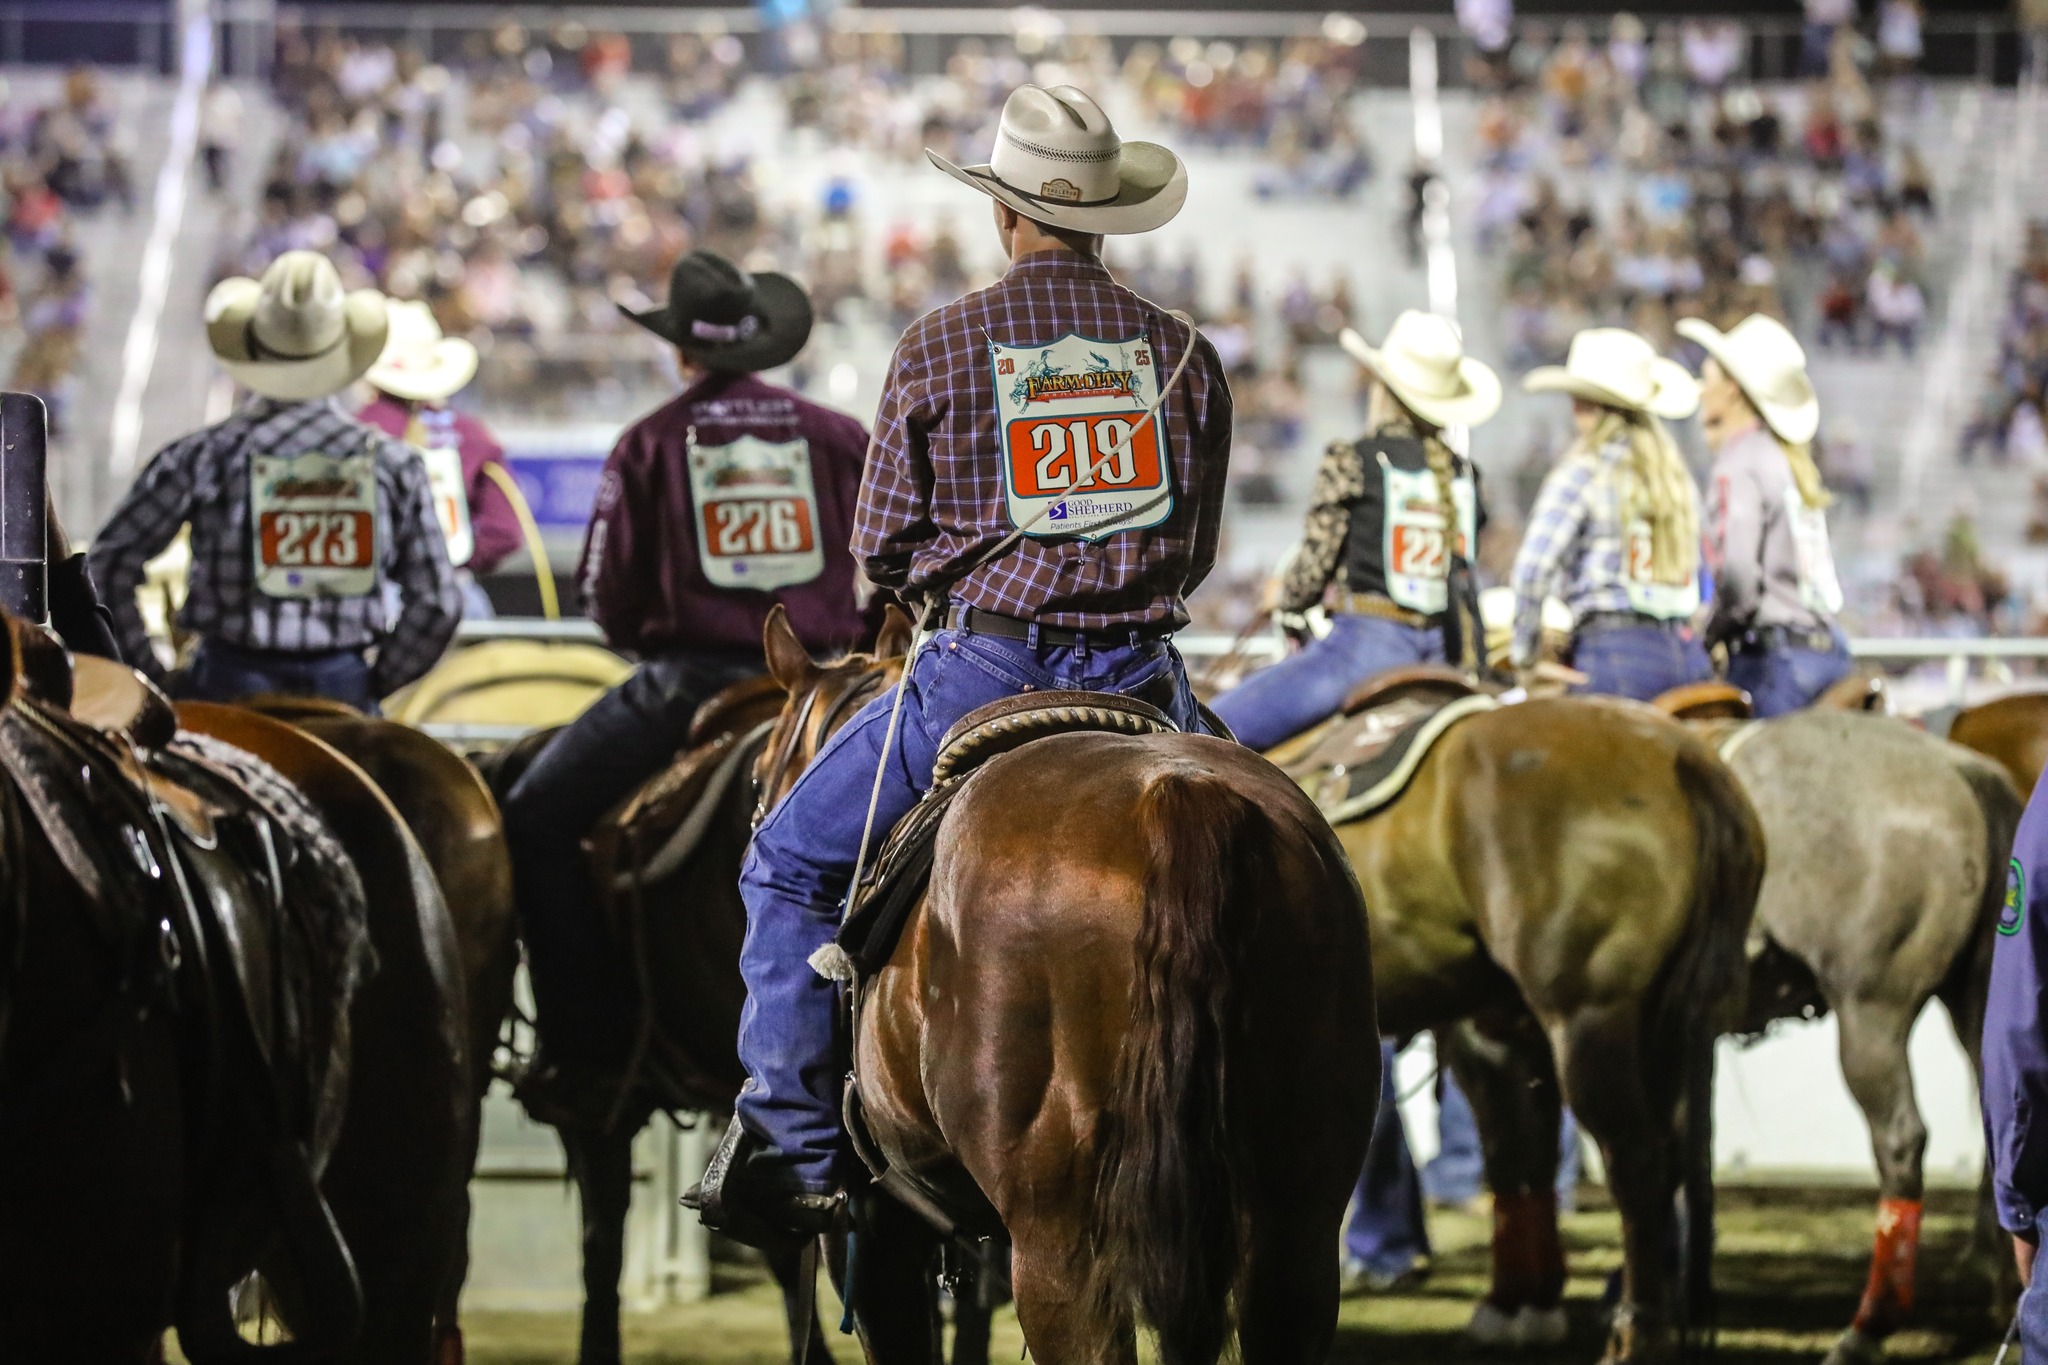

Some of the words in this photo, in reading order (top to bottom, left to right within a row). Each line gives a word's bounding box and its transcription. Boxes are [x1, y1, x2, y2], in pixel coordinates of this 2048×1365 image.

[997, 358, 1015, 375] 20
[1134, 350, 1151, 366] 25
[1030, 417, 1139, 490] 219
[1067, 499, 1093, 507] GOOD
[1068, 502, 1133, 516] SHEPHERD
[715, 502, 802, 554] 276
[1050, 521, 1082, 531] Patients
[274, 513, 359, 566] 273
